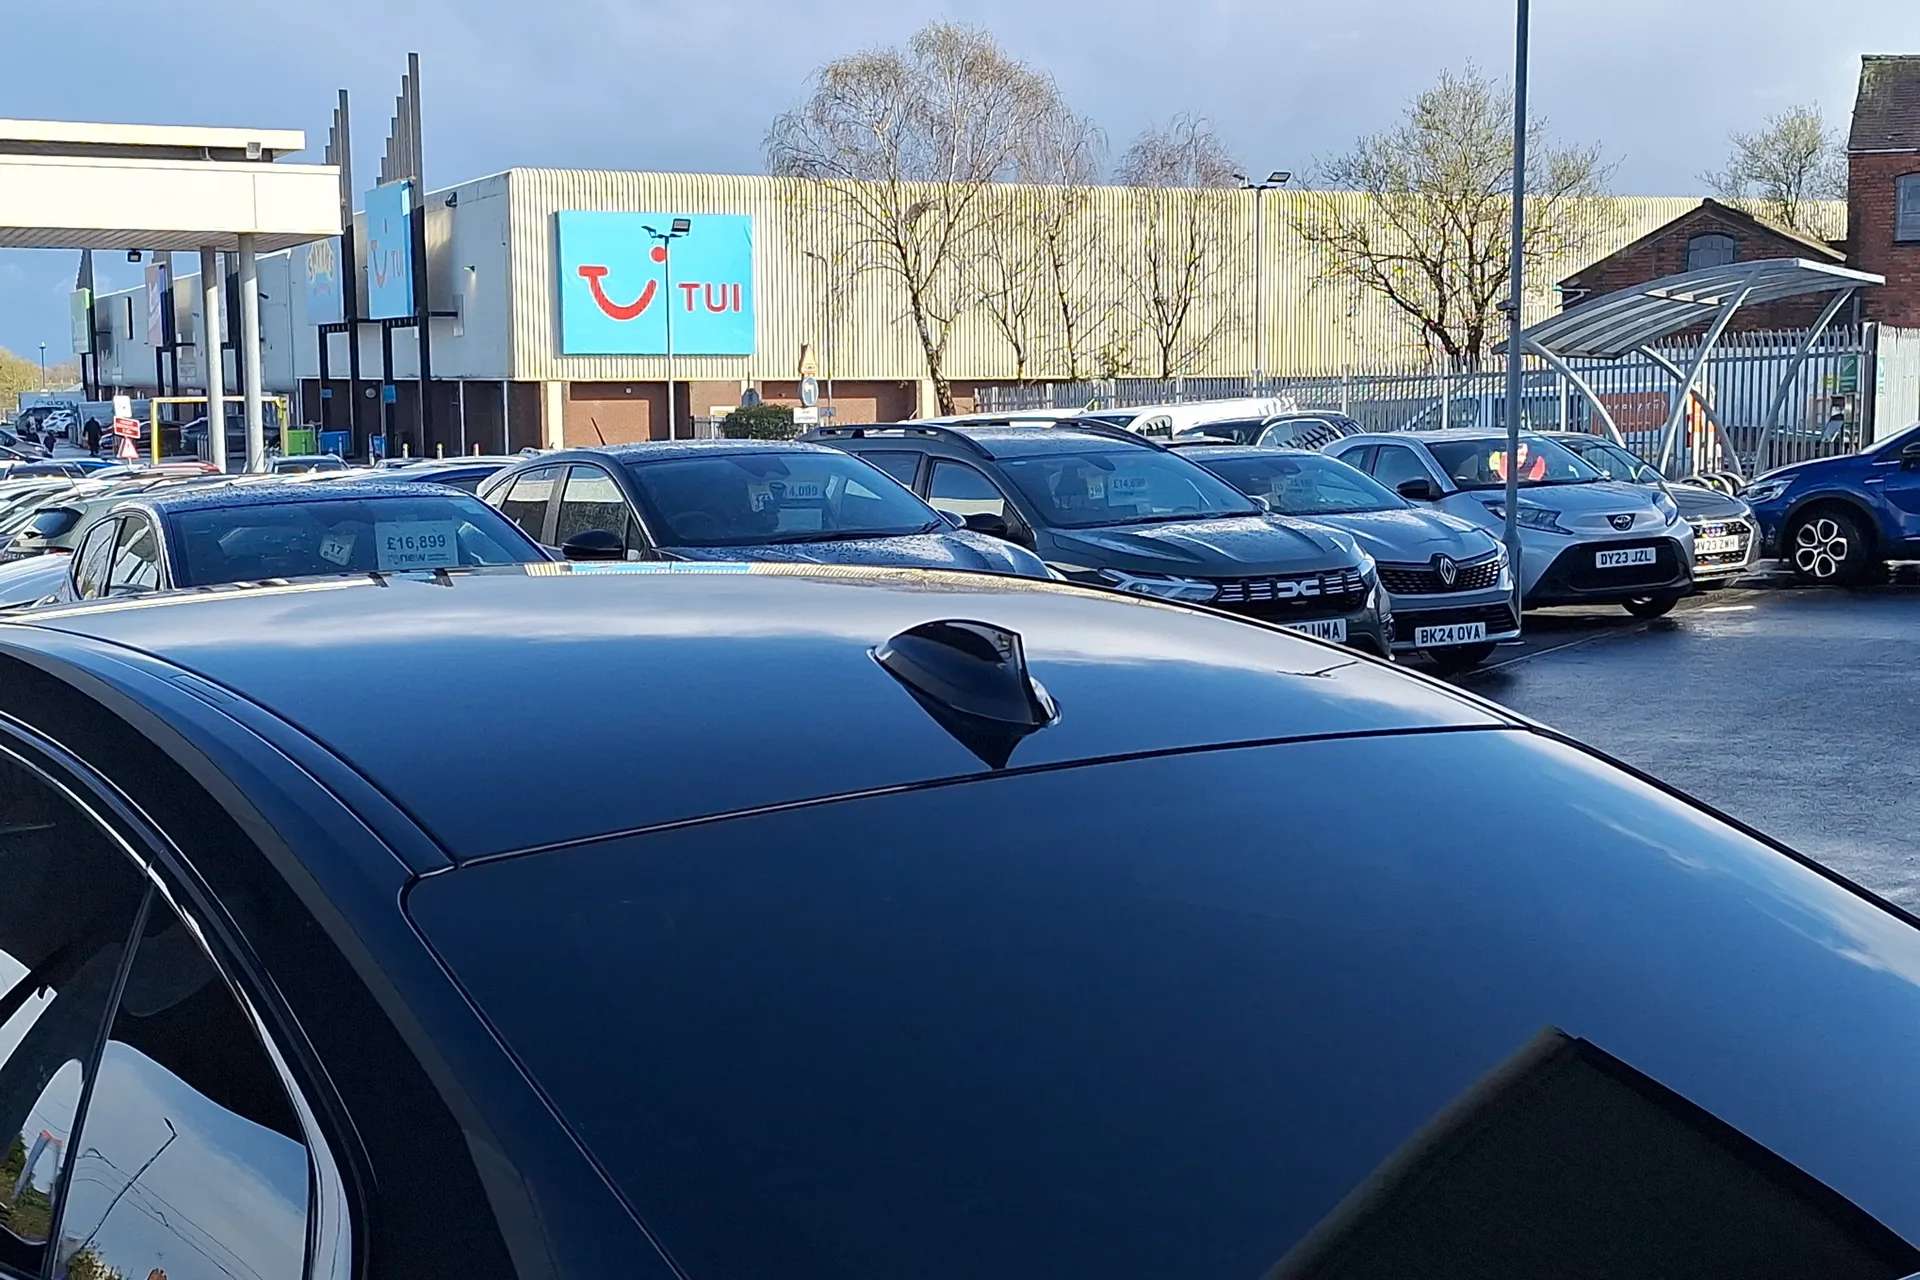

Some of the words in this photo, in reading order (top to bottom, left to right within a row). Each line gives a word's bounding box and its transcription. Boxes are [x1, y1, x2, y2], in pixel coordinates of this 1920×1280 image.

[678, 282, 741, 313] TUI
[328, 542, 345, 555] 17
[386, 534, 446, 551] £16,899
[1600, 551, 1629, 565] DY23
[1631, 549, 1651, 563] JZL
[1311, 621, 1341, 641] UMA
[1420, 627, 1455, 645] BK24
[1457, 624, 1481, 641] OVA
